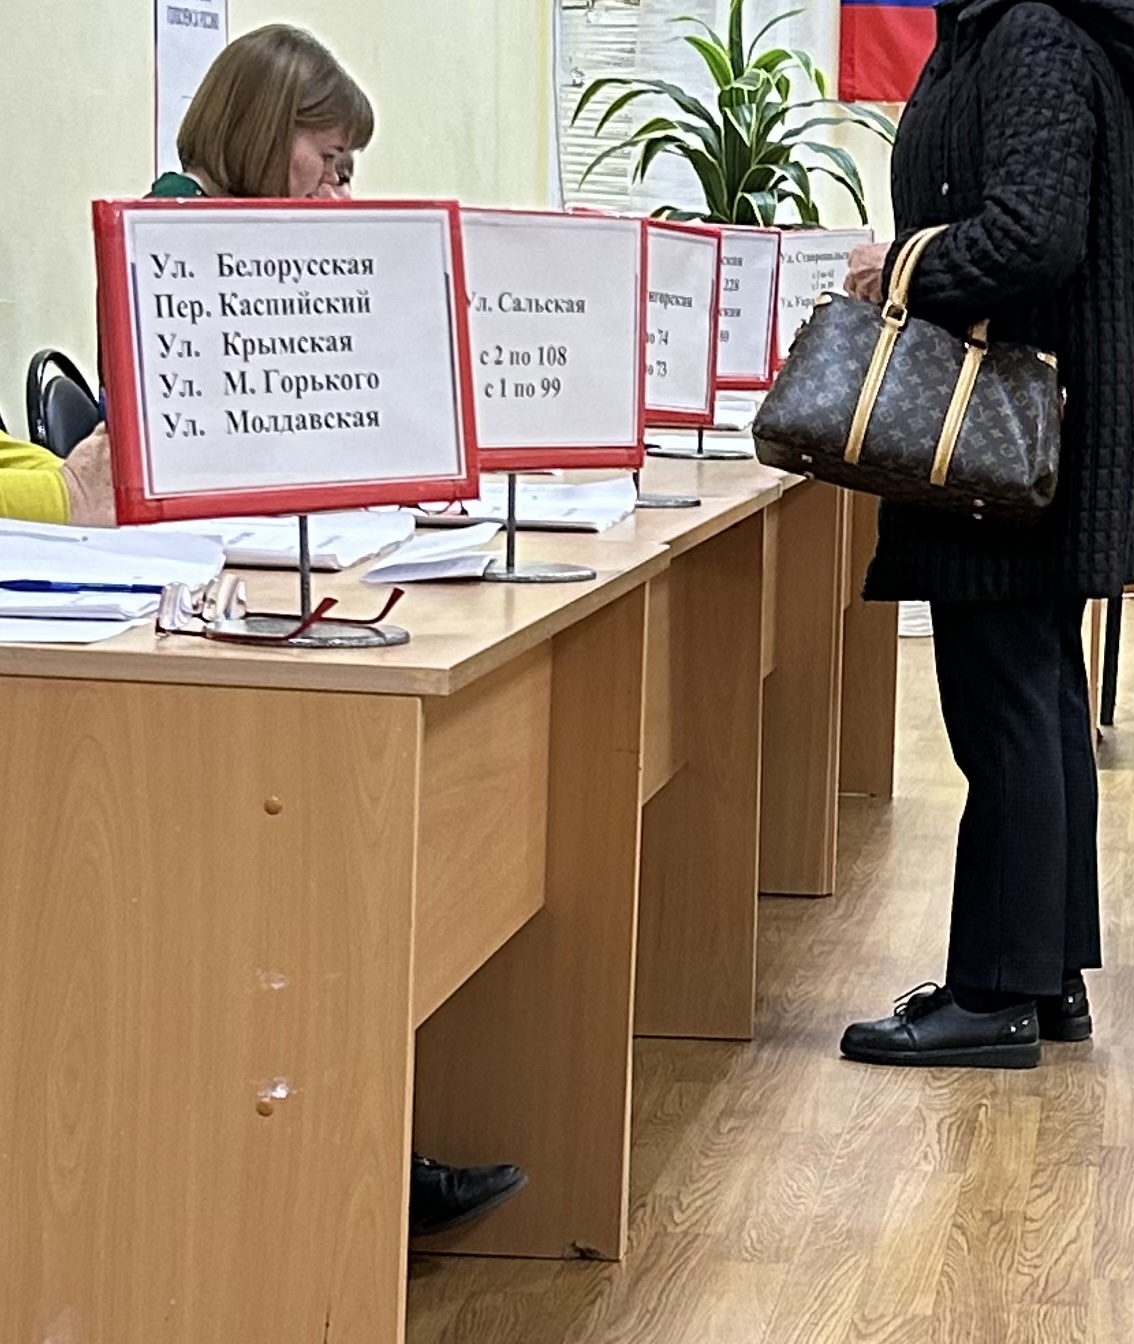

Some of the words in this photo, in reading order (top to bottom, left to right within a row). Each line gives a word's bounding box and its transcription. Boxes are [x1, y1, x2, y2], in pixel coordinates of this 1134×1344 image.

[150, 253, 196, 279] Ул.
[217, 252, 375, 284] Белорусская
[153, 293, 212, 325] Пер.
[218, 288, 372, 317] Каспийский
[497, 291, 586, 313] Сальская
[157, 332, 201, 359] Ул.
[221, 331, 353, 363] Крымская
[479, 350, 489, 366] с
[494, 344, 503, 366] 2
[509, 349, 531, 366] по
[538, 345, 568, 367] 108
[158, 373, 203, 399] Ул.
[223, 370, 257, 396] М.
[262, 369, 380, 400] Горького
[484, 382, 494, 398] с
[500, 377, 507, 398] 1
[514, 382, 536, 398] по
[541, 377, 561, 398] 99
[161, 412, 206, 438] Ул.
[225, 409, 381, 436] Молдавская
